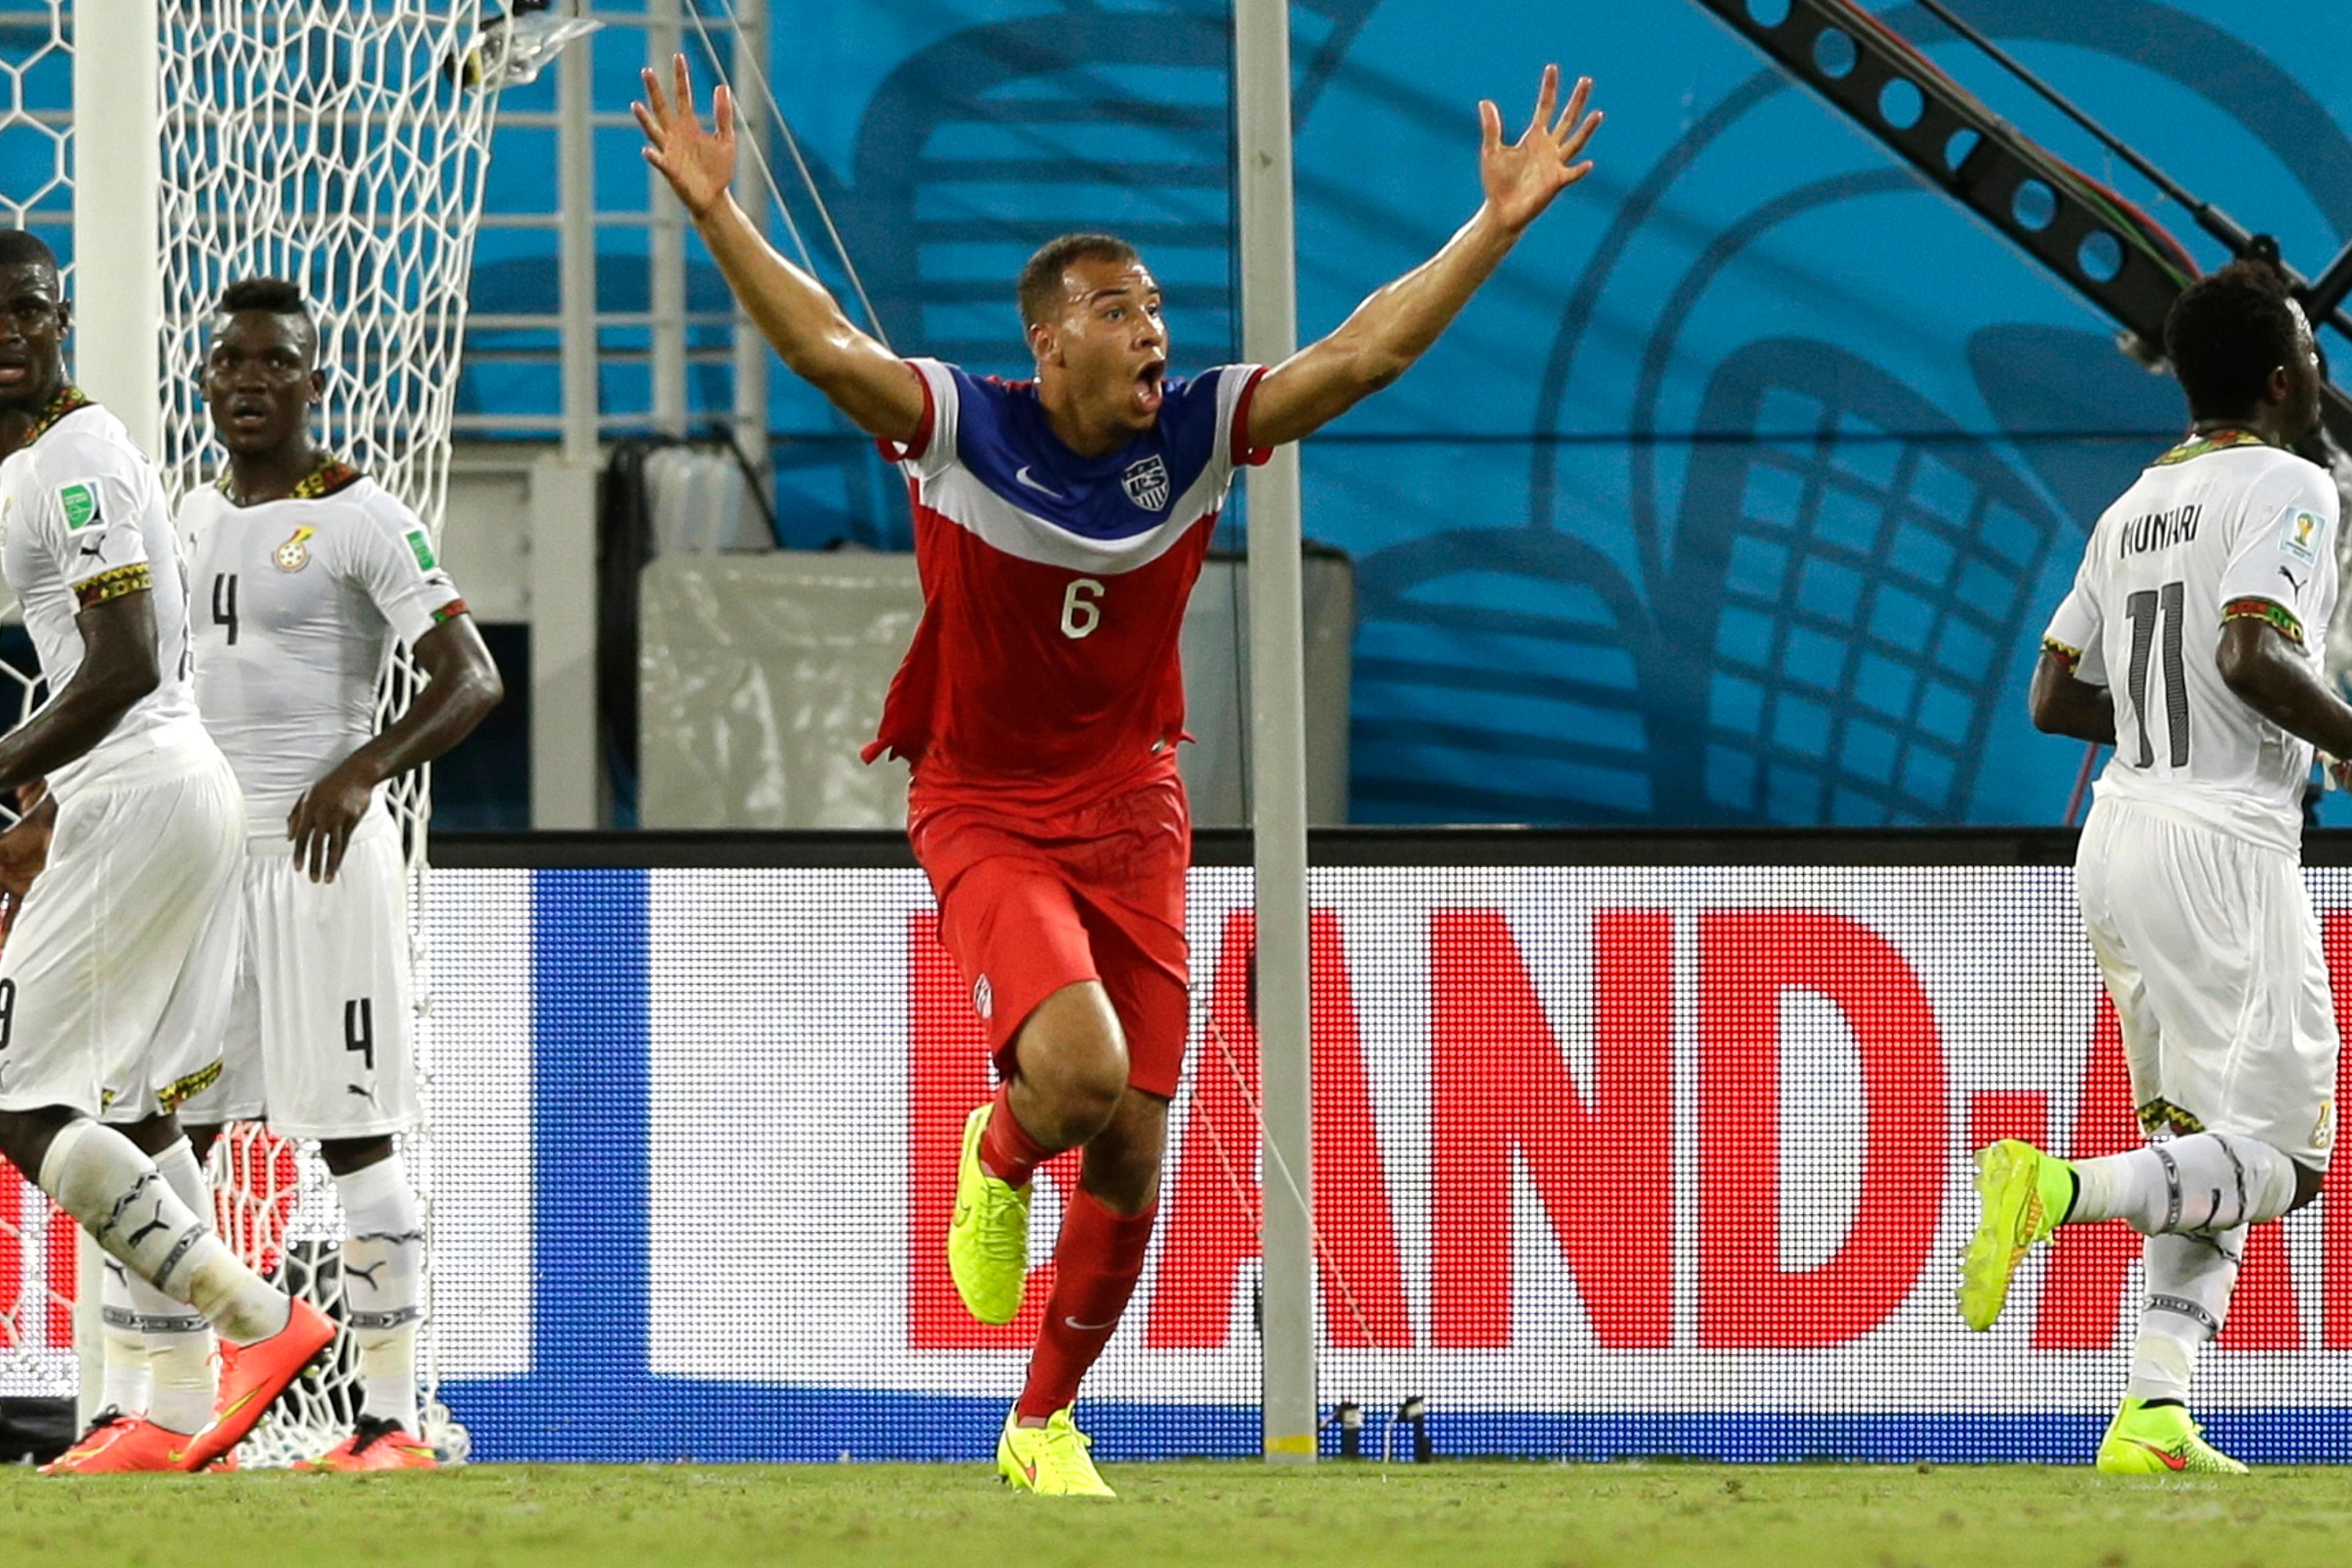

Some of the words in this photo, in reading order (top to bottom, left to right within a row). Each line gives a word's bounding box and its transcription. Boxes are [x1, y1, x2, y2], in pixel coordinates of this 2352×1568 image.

[213, 573, 238, 646] 4
[1060, 578, 1105, 639] 6
[2125, 581, 2189, 769] 11
[345, 998, 374, 1070] 4
